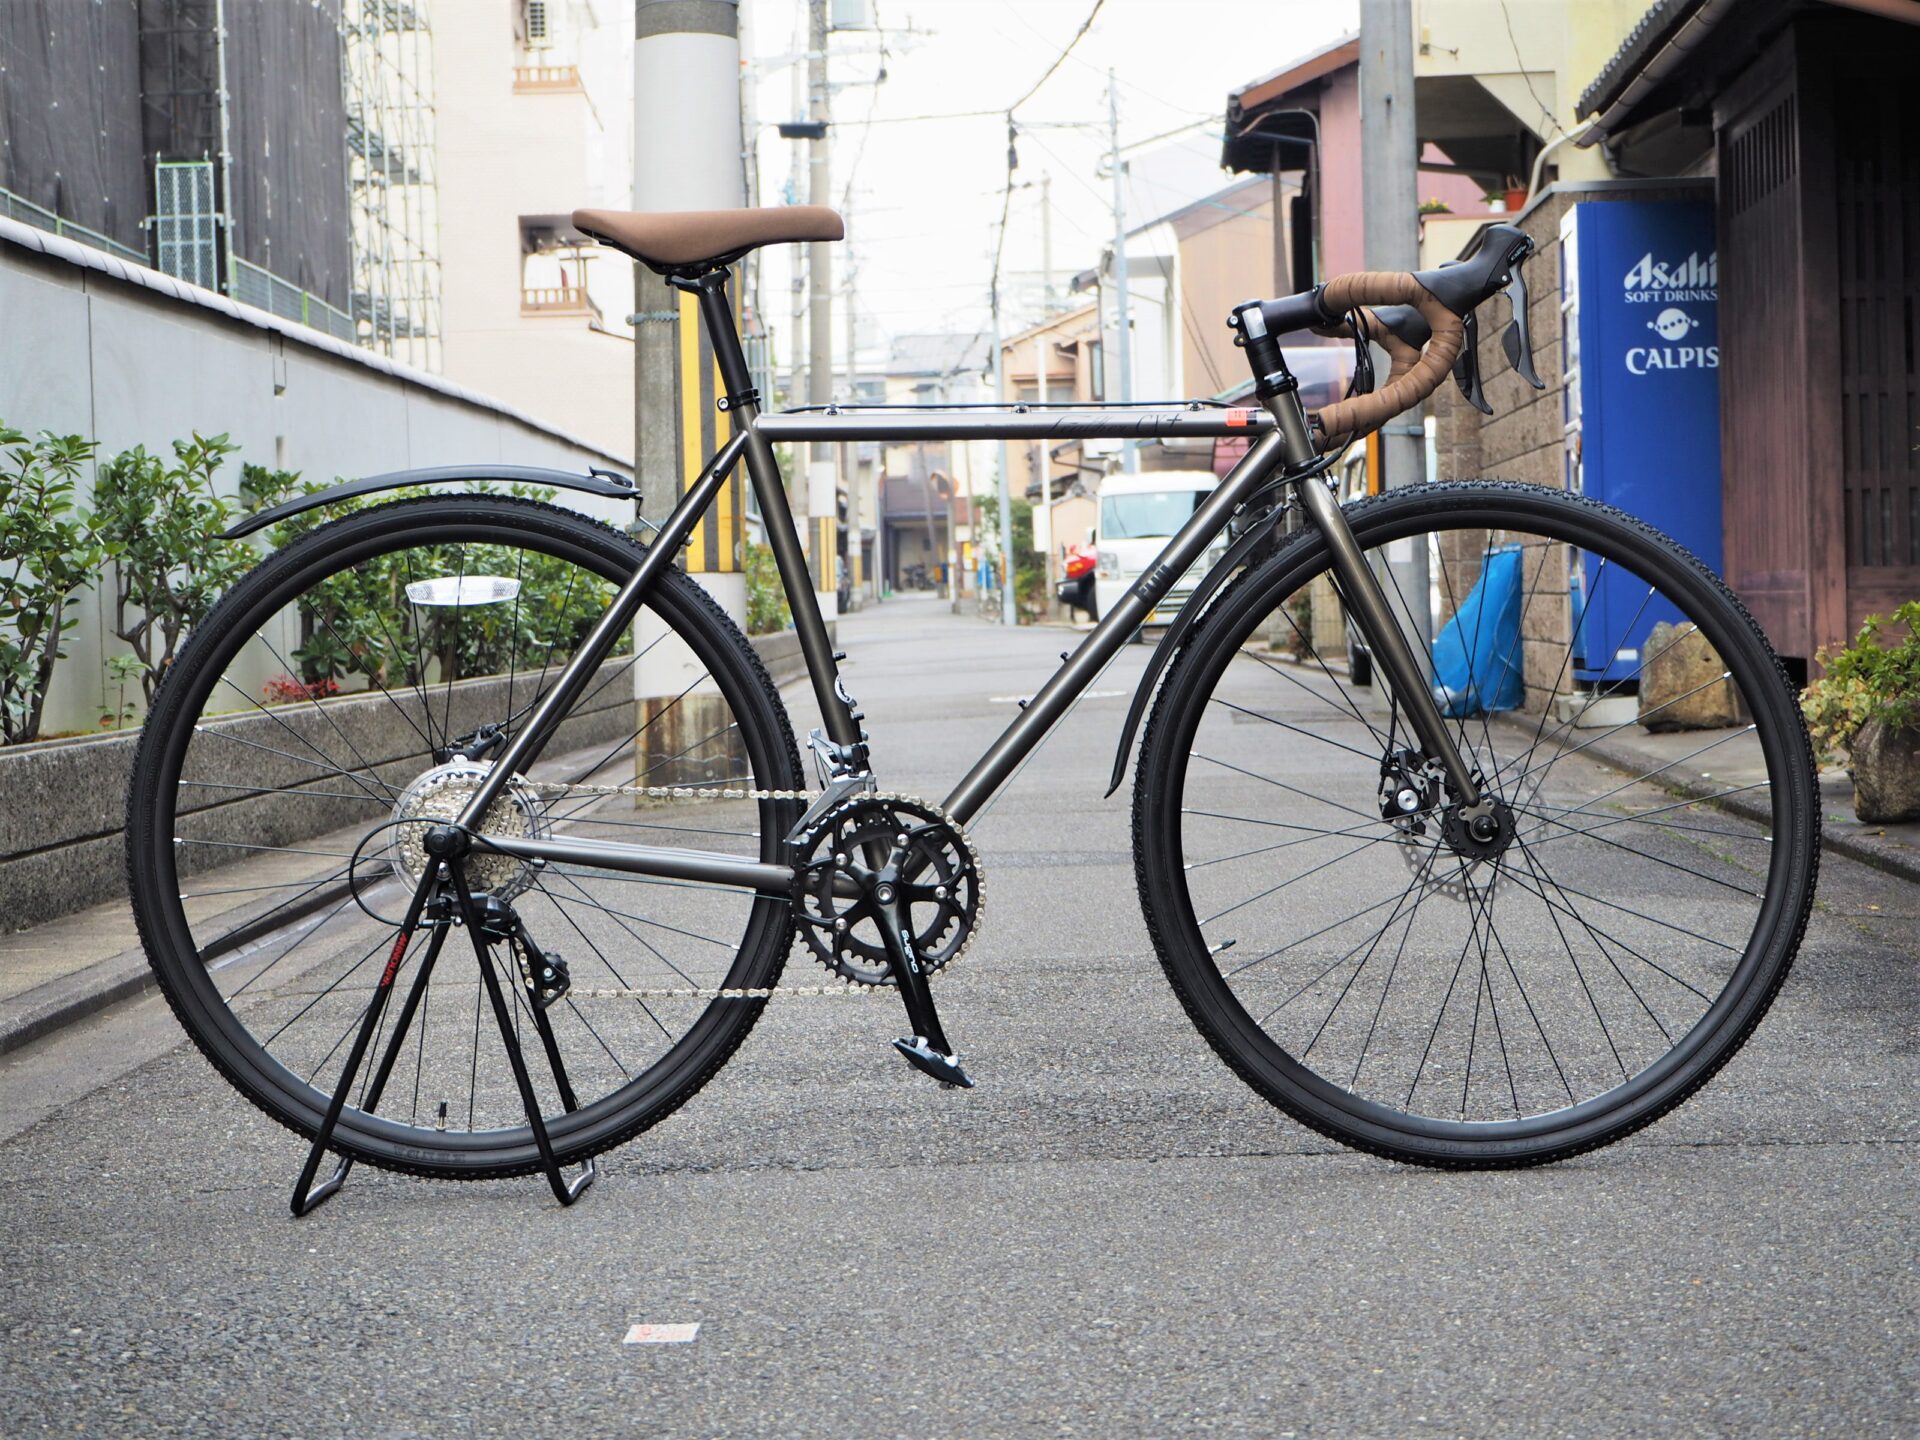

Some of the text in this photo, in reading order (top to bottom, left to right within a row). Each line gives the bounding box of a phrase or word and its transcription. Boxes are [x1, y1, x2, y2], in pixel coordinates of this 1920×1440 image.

[1624, 251, 1718, 290] Asahi
[1624, 289, 1718, 303] SOFT DRINKS
[1625, 346, 1720, 375] CALPIS
